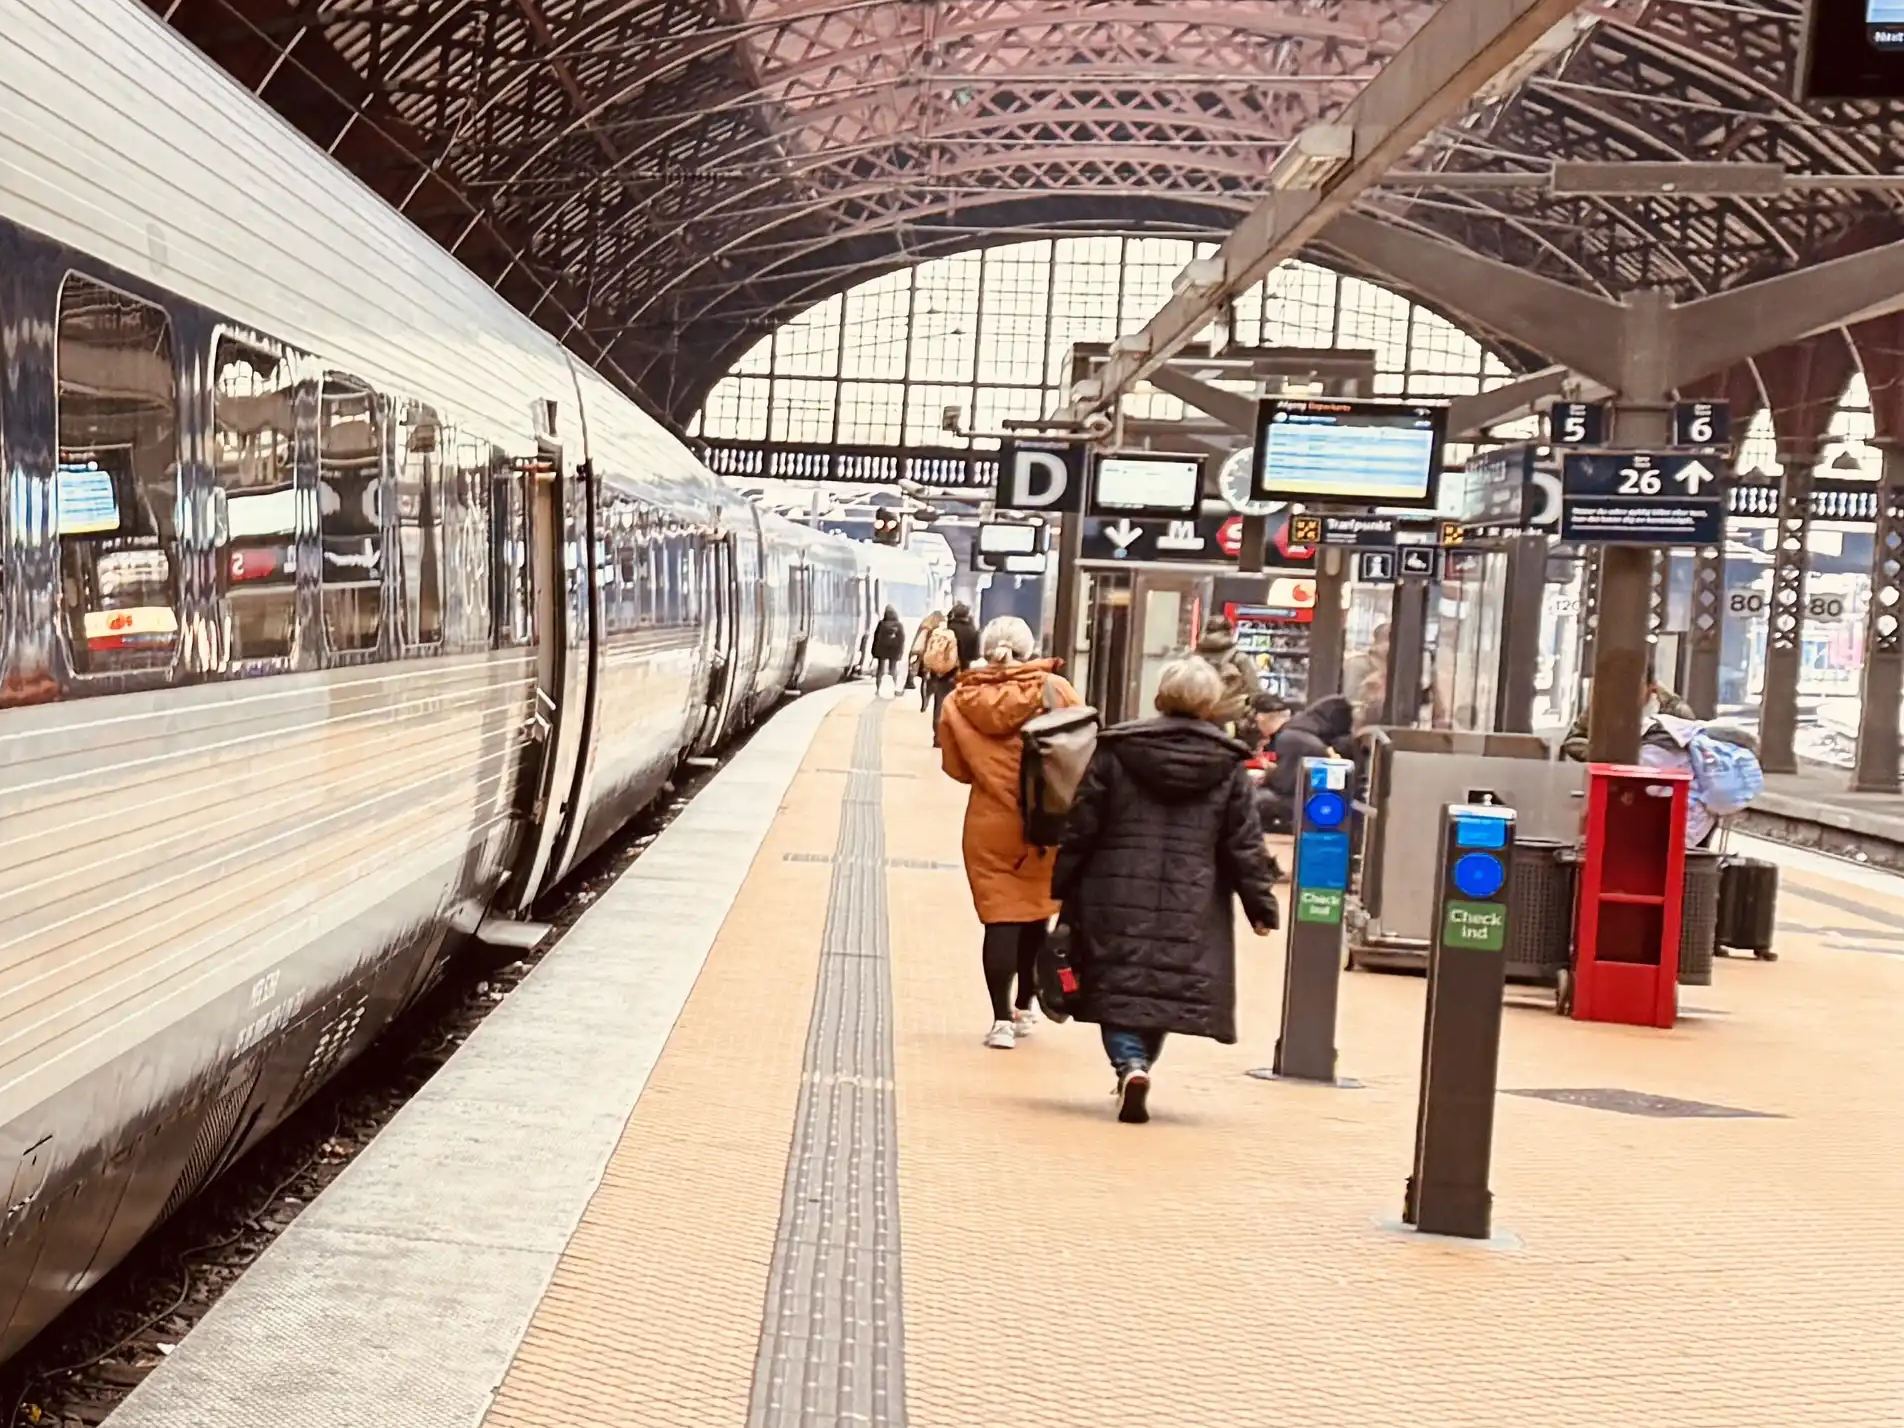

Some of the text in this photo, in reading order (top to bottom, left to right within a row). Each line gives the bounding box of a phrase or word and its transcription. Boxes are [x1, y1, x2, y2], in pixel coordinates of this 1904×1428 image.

[1563, 417, 1585, 442] 5
[1691, 417, 1712, 442] 6
[1011, 451, 1068, 506] D
[1618, 469, 1662, 494] 26
[1730, 594, 1764, 612] 80
[1809, 598, 1843, 617] 80
[1449, 908, 1503, 926] Check
[1461, 925, 1489, 940] ind
